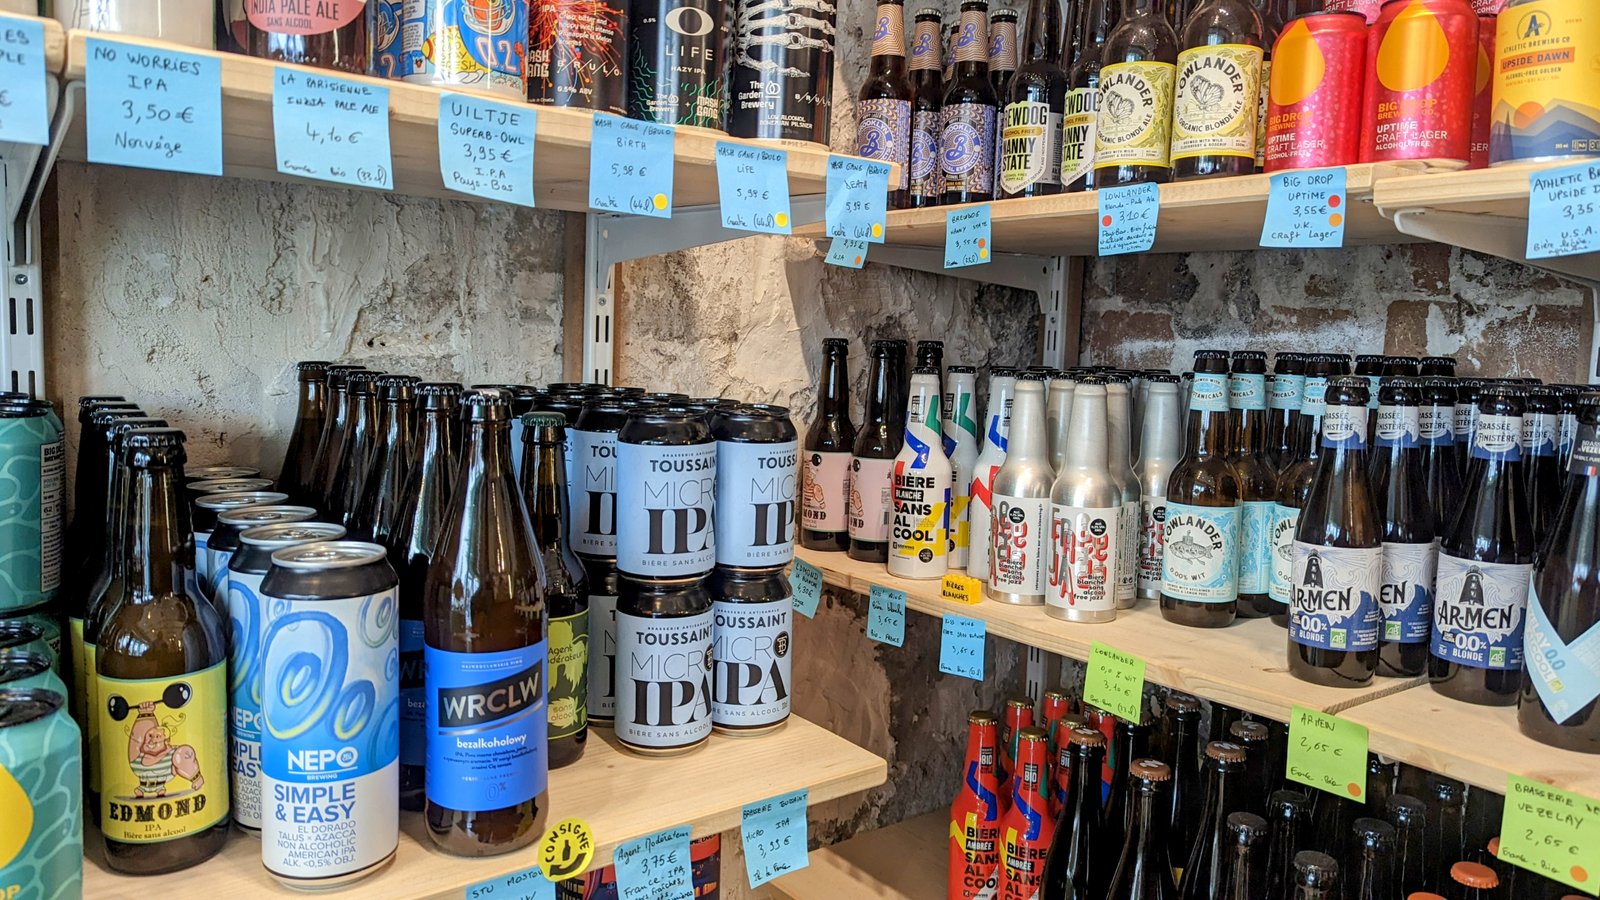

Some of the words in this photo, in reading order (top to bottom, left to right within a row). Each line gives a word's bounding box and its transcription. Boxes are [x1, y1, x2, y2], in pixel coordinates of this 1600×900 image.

[281, 0, 310, 17] PALE
[316, 4, 339, 22] ALE
[94, 47, 117, 63] NO
[528, 50, 551, 65] ASH
[1502, 55, 1533, 70] UPSIDE
[1537, 50, 1570, 63] DAWN
[527, 62, 550, 78] ANG
[694, 67, 707, 75] IPA
[128, 74, 168, 93] IPA
[282, 74, 296, 86] LA
[750, 80, 765, 90] The
[1178, 56, 1244, 101] LOWLANDER
[738, 91, 765, 100] Garden
[1098, 73, 1154, 112] OWLANDER
[741, 100, 775, 110] Brewery
[1378, 102, 1397, 113] BIG
[451, 104, 521, 127] UILTJE
[1205, 114, 1234, 131] BLONDE
[1234, 100, 1243, 117] ALE
[306, 121, 343, 145] 4,10
[348, 131, 364, 144] €
[1117, 126, 1145, 143] BLONDE
[1376, 121, 1417, 134] UPTIME
[1376, 132, 1407, 143] CRAFT
[1412, 129, 1448, 140] LAGER
[463, 145, 496, 163] 3,95
[498, 150, 514, 163] €
[1063, 143, 1084, 163] TATE
[1292, 141, 1324, 151] LAGER
[1002, 155, 1031, 172] STATE
[1307, 173, 1334, 186] DROP
[1105, 186, 1152, 201] LOWLANDER
[1549, 186, 1586, 202] UPSIDE
[1562, 202, 1594, 220] 3,35
[649, 457, 716, 473] TOUSSAIN
[757, 454, 796, 470] TOUSS
[894, 472, 936, 489] BIÈRE
[644, 477, 714, 507] MICR
[895, 490, 923, 501] BLANCHE
[893, 503, 932, 516] SANS
[893, 515, 911, 527] AL
[642, 506, 716, 556] IPA
[893, 529, 933, 542] COOL
[1164, 515, 1223, 551] LOWLANDER
[672, 556, 694, 567] SANS
[1380, 580, 1407, 604] EN
[713, 612, 787, 629] OUSSAINT
[636, 624, 713, 646] TOUSSAINT
[1299, 631, 1325, 643] BLONDE
[548, 645, 574, 657] Agent
[1452, 648, 1484, 663] BLONDE
[712, 658, 788, 706] IPA
[443, 670, 540, 721] WRCLW
[630, 672, 712, 726] IPA
[456, 732, 528, 750] bezalkoholowy
[657, 730, 680, 738] SANS
[1300, 736, 1329, 753] 2,65
[288, 747, 359, 772] NEPO
[274, 782, 356, 804] SIMPLE
[109, 794, 207, 824] EDMOND
[275, 805, 288, 823] &
[293, 803, 357, 824] EASY
[145, 824, 162, 832] IPA
[298, 825, 310, 835] EL
[312, 820, 357, 834] DORADO
[775, 816, 790, 830] IPA
[124, 831, 142, 840] Bière
[145, 829, 163, 838] sans
[166, 826, 187, 837] alcool
[278, 831, 307, 842] TALUS
[314, 829, 357, 843] AZACCA
[967, 824, 999, 840] BIÈR
[278, 841, 301, 851] NON
[303, 837, 356, 849] ALCOHOLIC
[545, 822, 590, 863] CONSIGNE
[967, 841, 992, 851] AMBRÉE
[288, 848, 335, 860] AMERICAN
[338, 847, 357, 857] IPA
[618, 846, 641, 865] Agent
[1007, 842, 1046, 860] BIÈRE
[641, 854, 666, 876] 3,75
[667, 849, 678, 864] €
[1007, 858, 1032, 871] AMBRÉE
[964, 865, 983, 877] AL
[472, 884, 494, 899] STU
[964, 877, 997, 890] COO
[1005, 883, 1022, 897] AL
